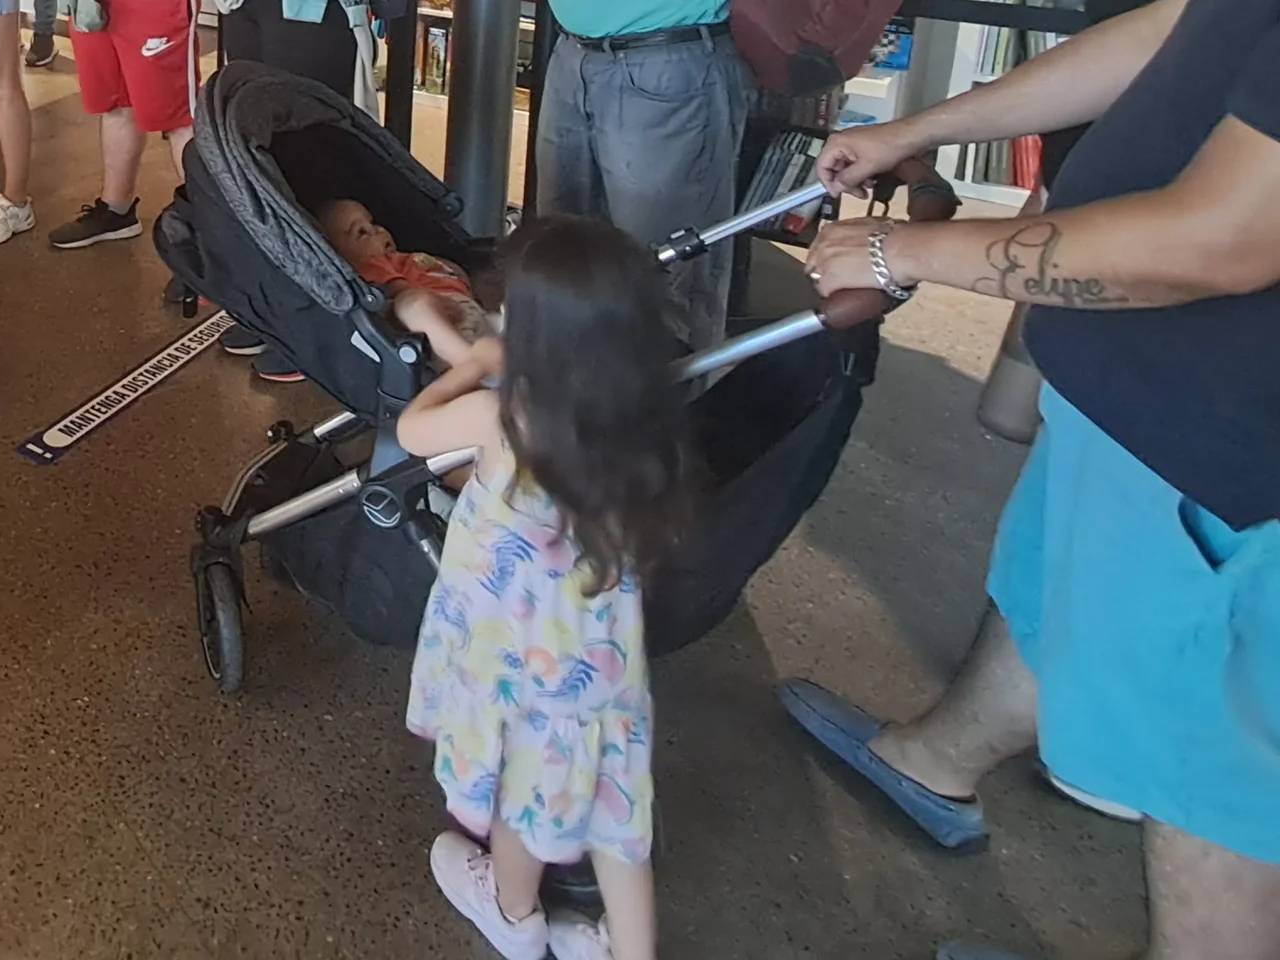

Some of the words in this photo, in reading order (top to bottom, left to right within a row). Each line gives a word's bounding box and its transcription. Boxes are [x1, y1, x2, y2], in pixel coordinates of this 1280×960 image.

[57, 390, 131, 438] MANTENGA
[120, 353, 185, 394] DISTANCIA
[173, 342, 198, 357] DE
